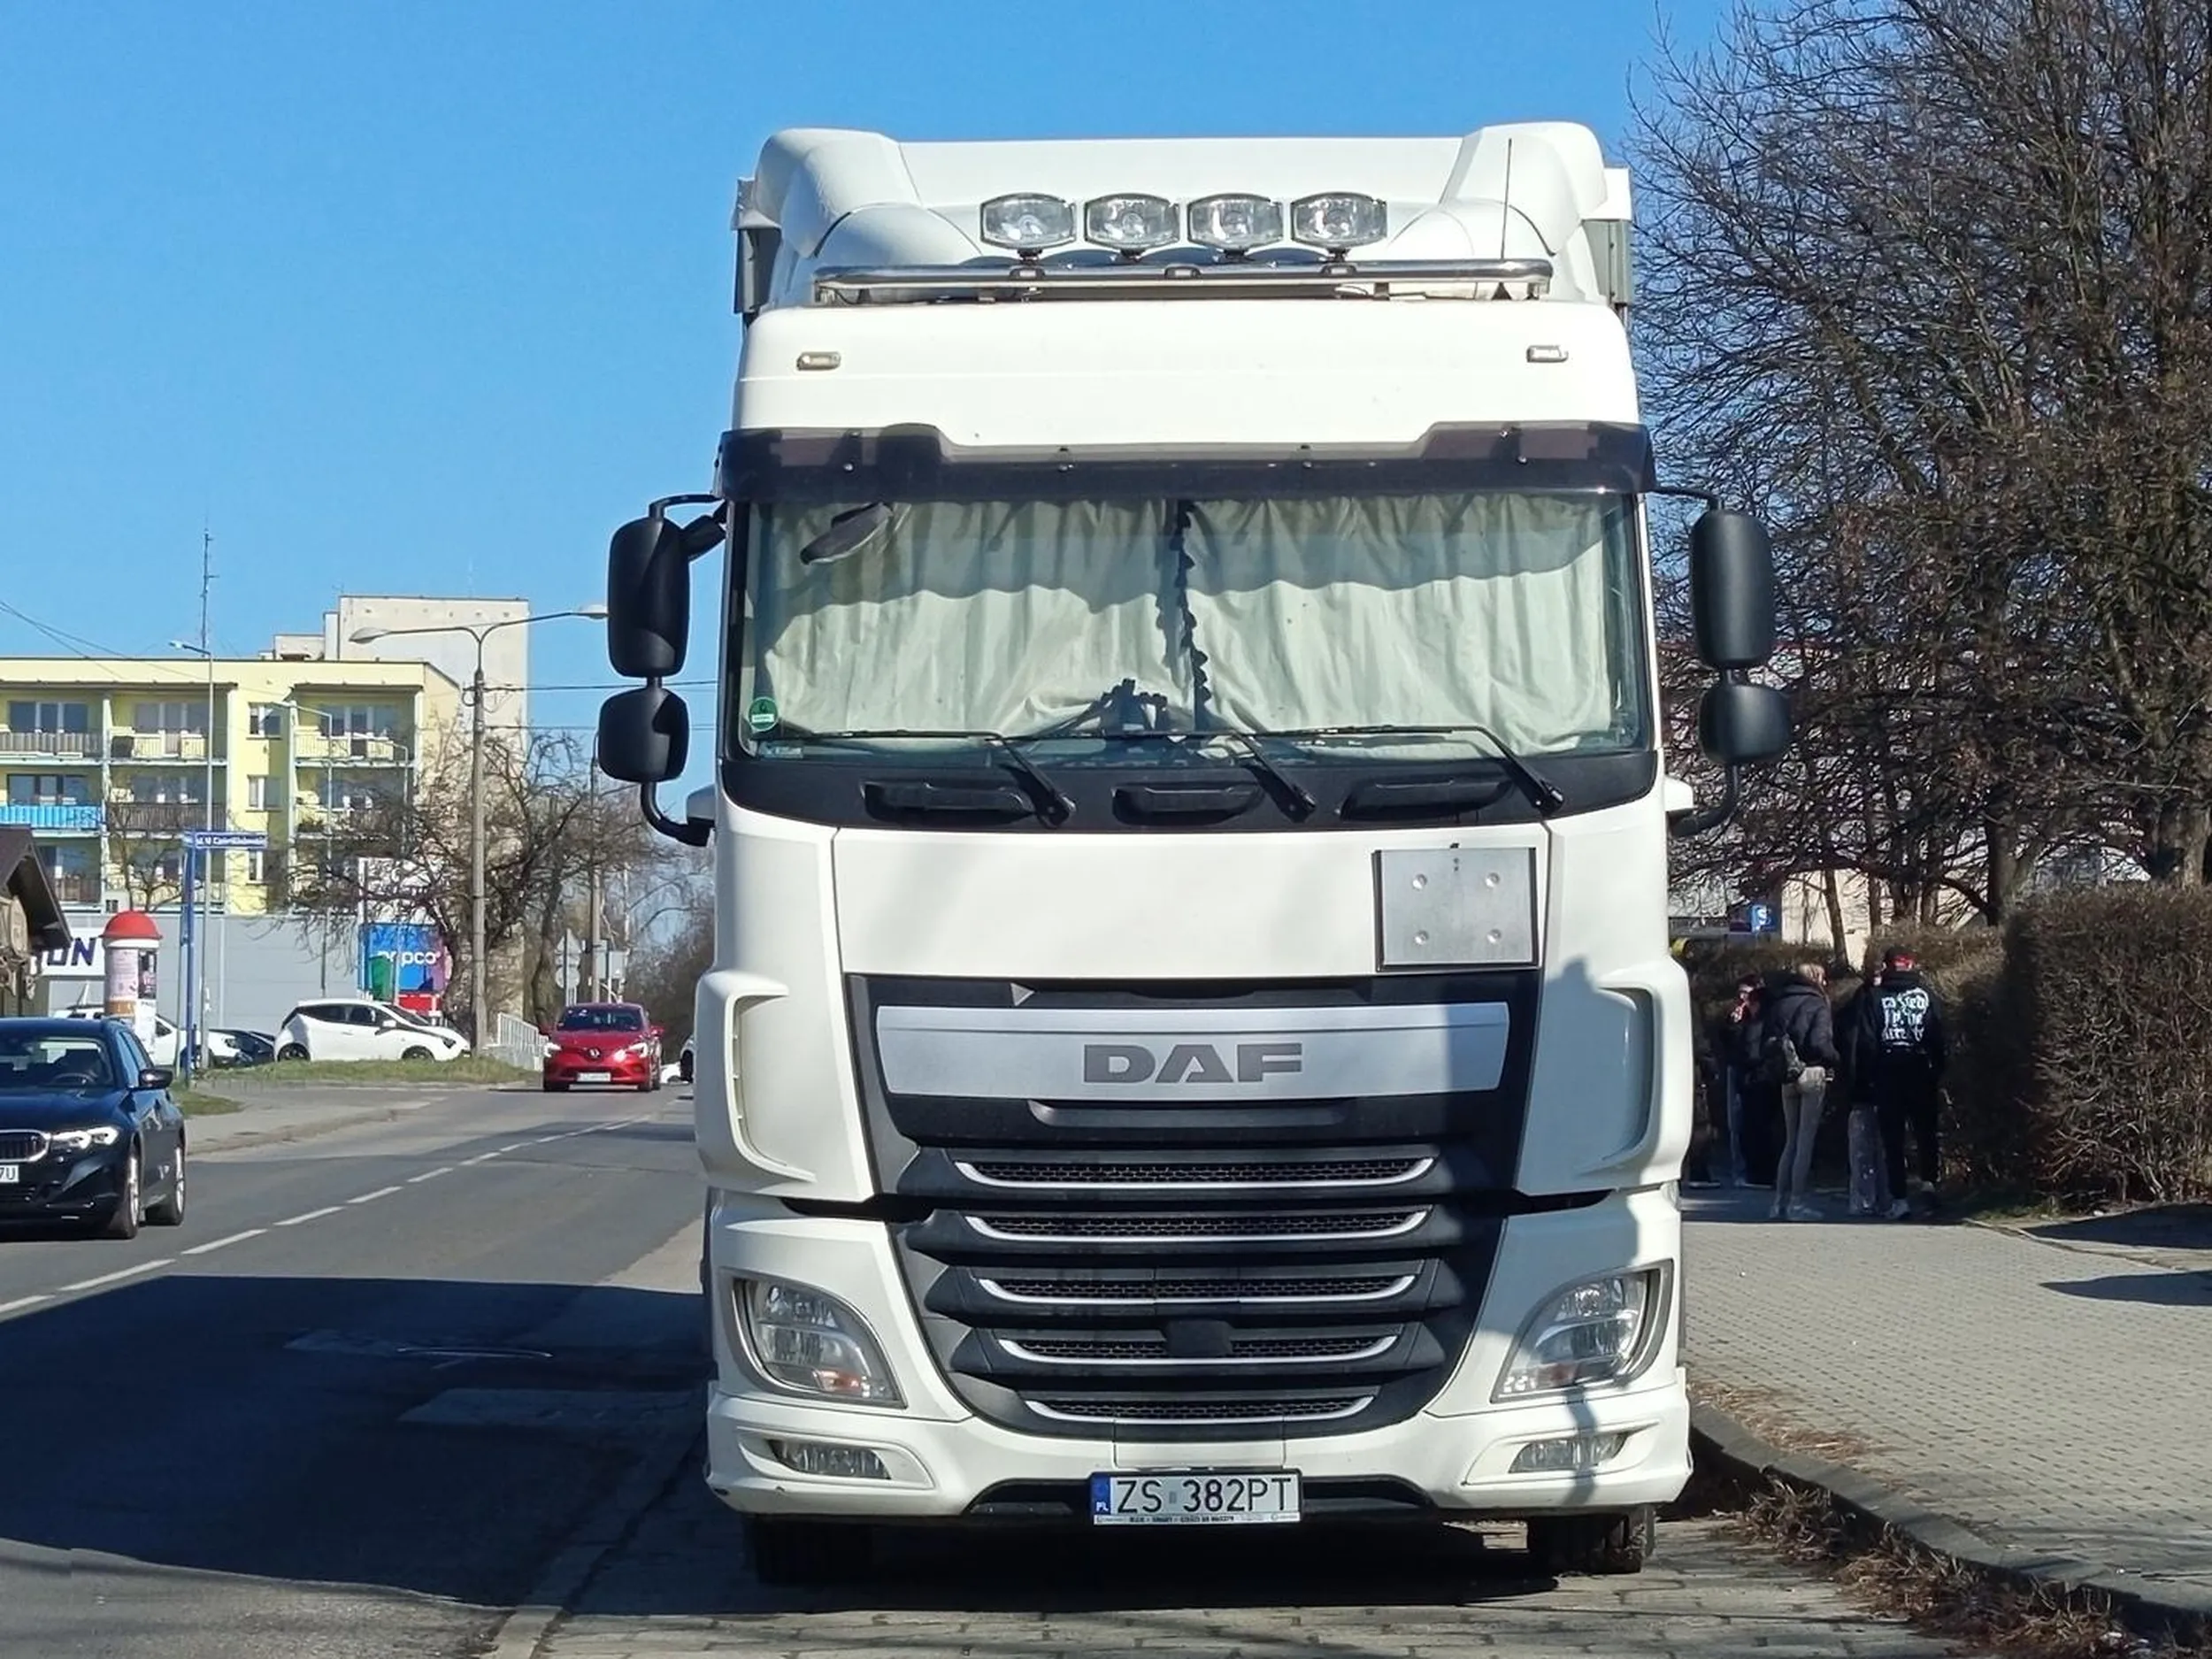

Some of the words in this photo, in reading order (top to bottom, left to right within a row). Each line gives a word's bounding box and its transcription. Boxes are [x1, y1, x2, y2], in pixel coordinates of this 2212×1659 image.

[377, 951, 437, 967] pco
[1084, 1043, 1302, 1083] DAF
[1117, 1479, 1164, 1514] ZS
[1182, 1478, 1292, 1512] 382PT
